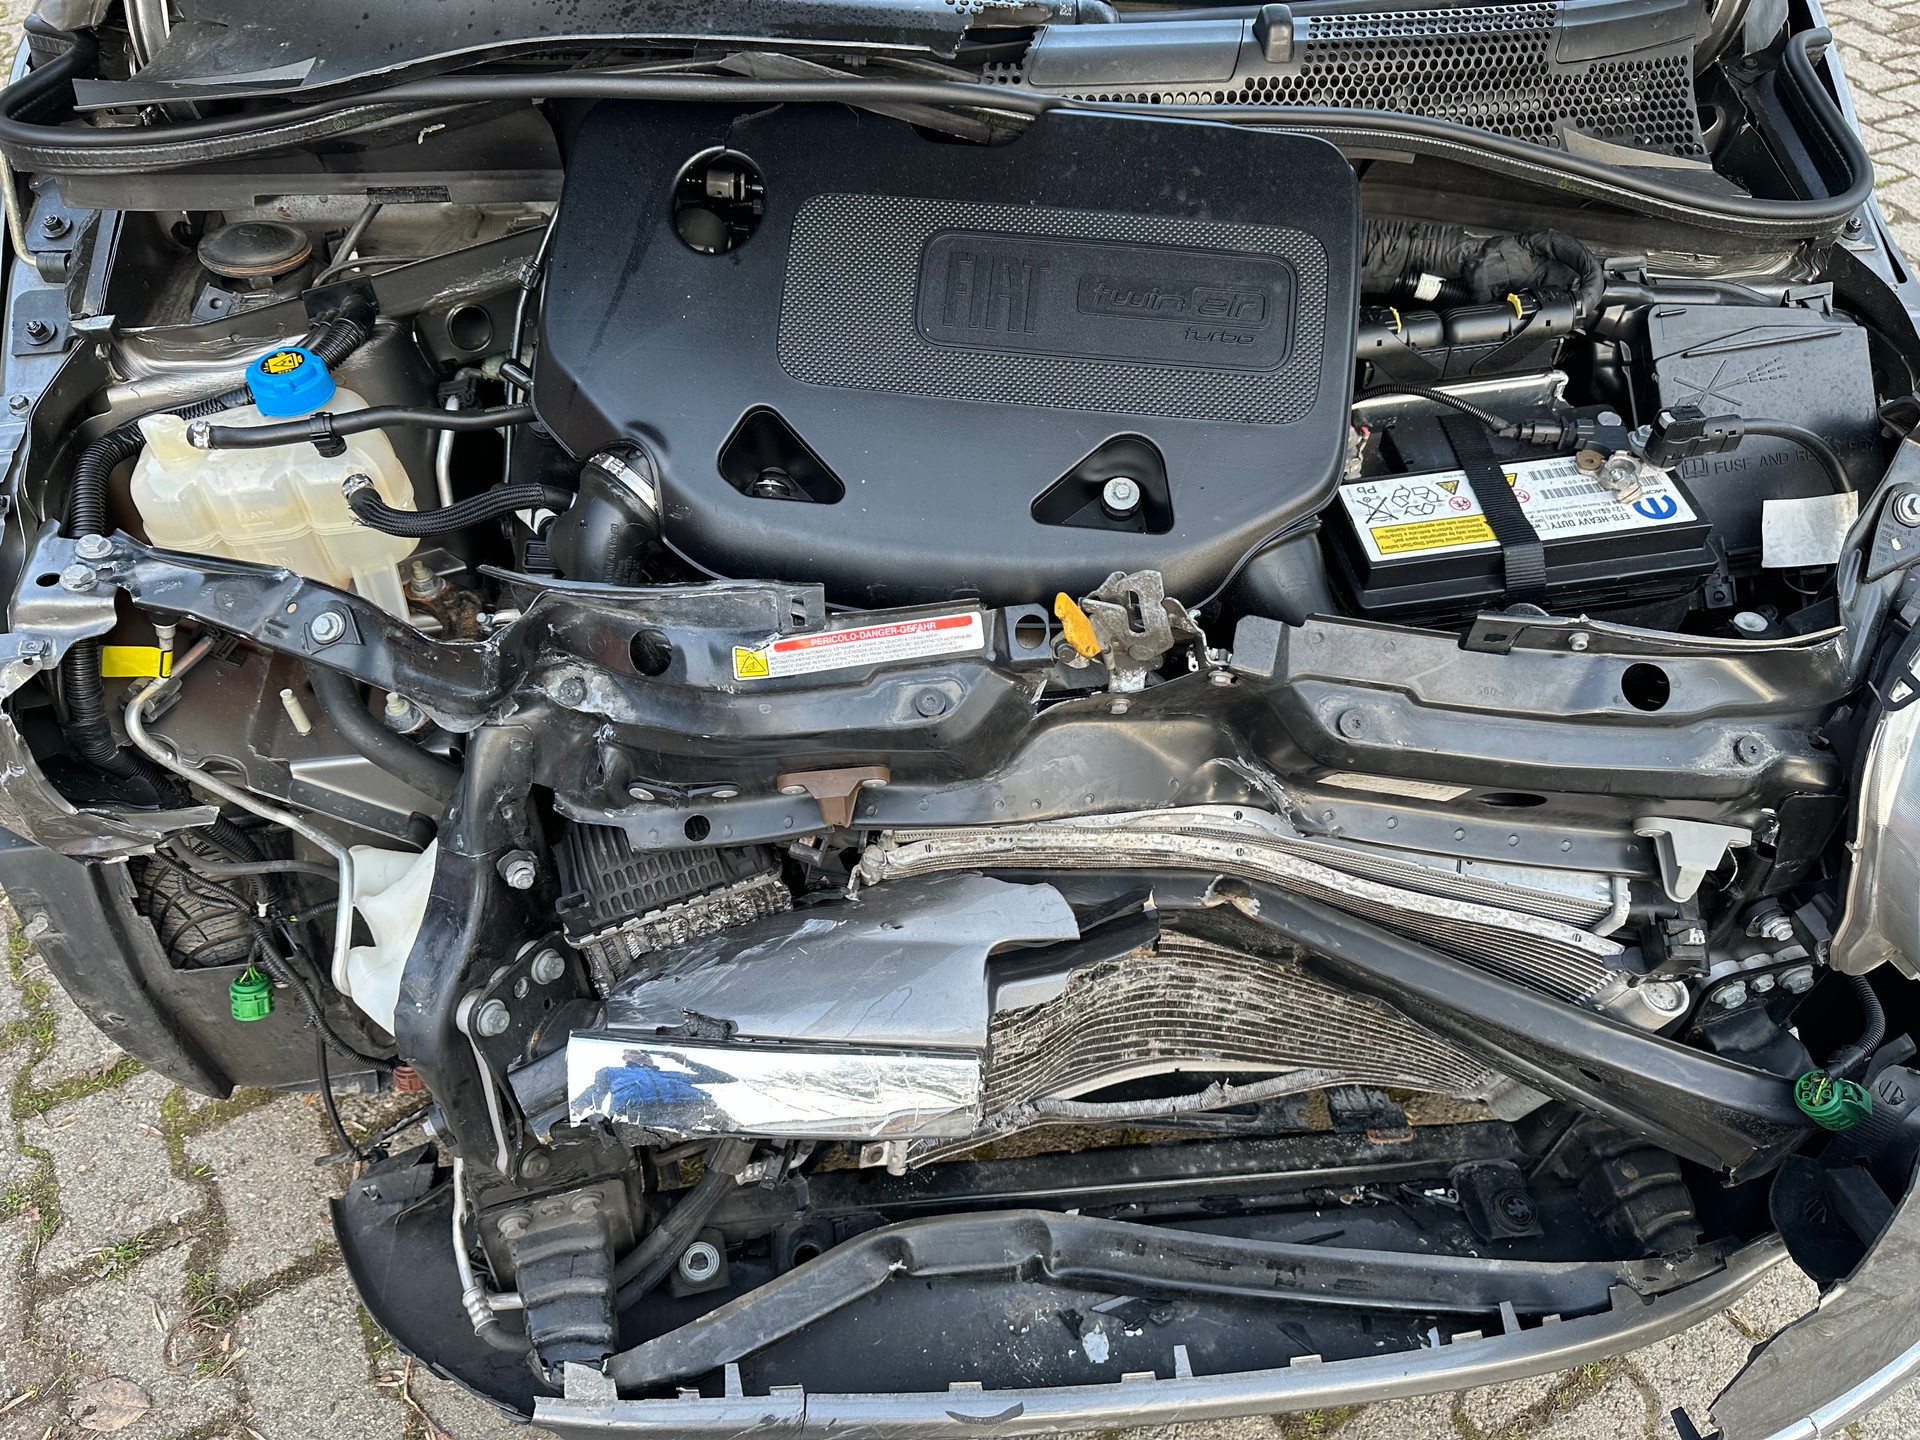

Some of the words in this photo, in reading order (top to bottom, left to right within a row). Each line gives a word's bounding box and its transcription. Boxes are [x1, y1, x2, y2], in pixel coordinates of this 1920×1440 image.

[943, 251, 1051, 334] FIAT
[1184, 327, 1257, 346] turbo
[1713, 457, 1752, 475] FUSE
[1759, 451, 1790, 468] AND
[1357, 486, 1377, 494] Pb
[235, 510, 271, 522] MAX
[1577, 512, 1630, 525] EFB-HEAVY
[1550, 519, 1575, 529] DUTY
